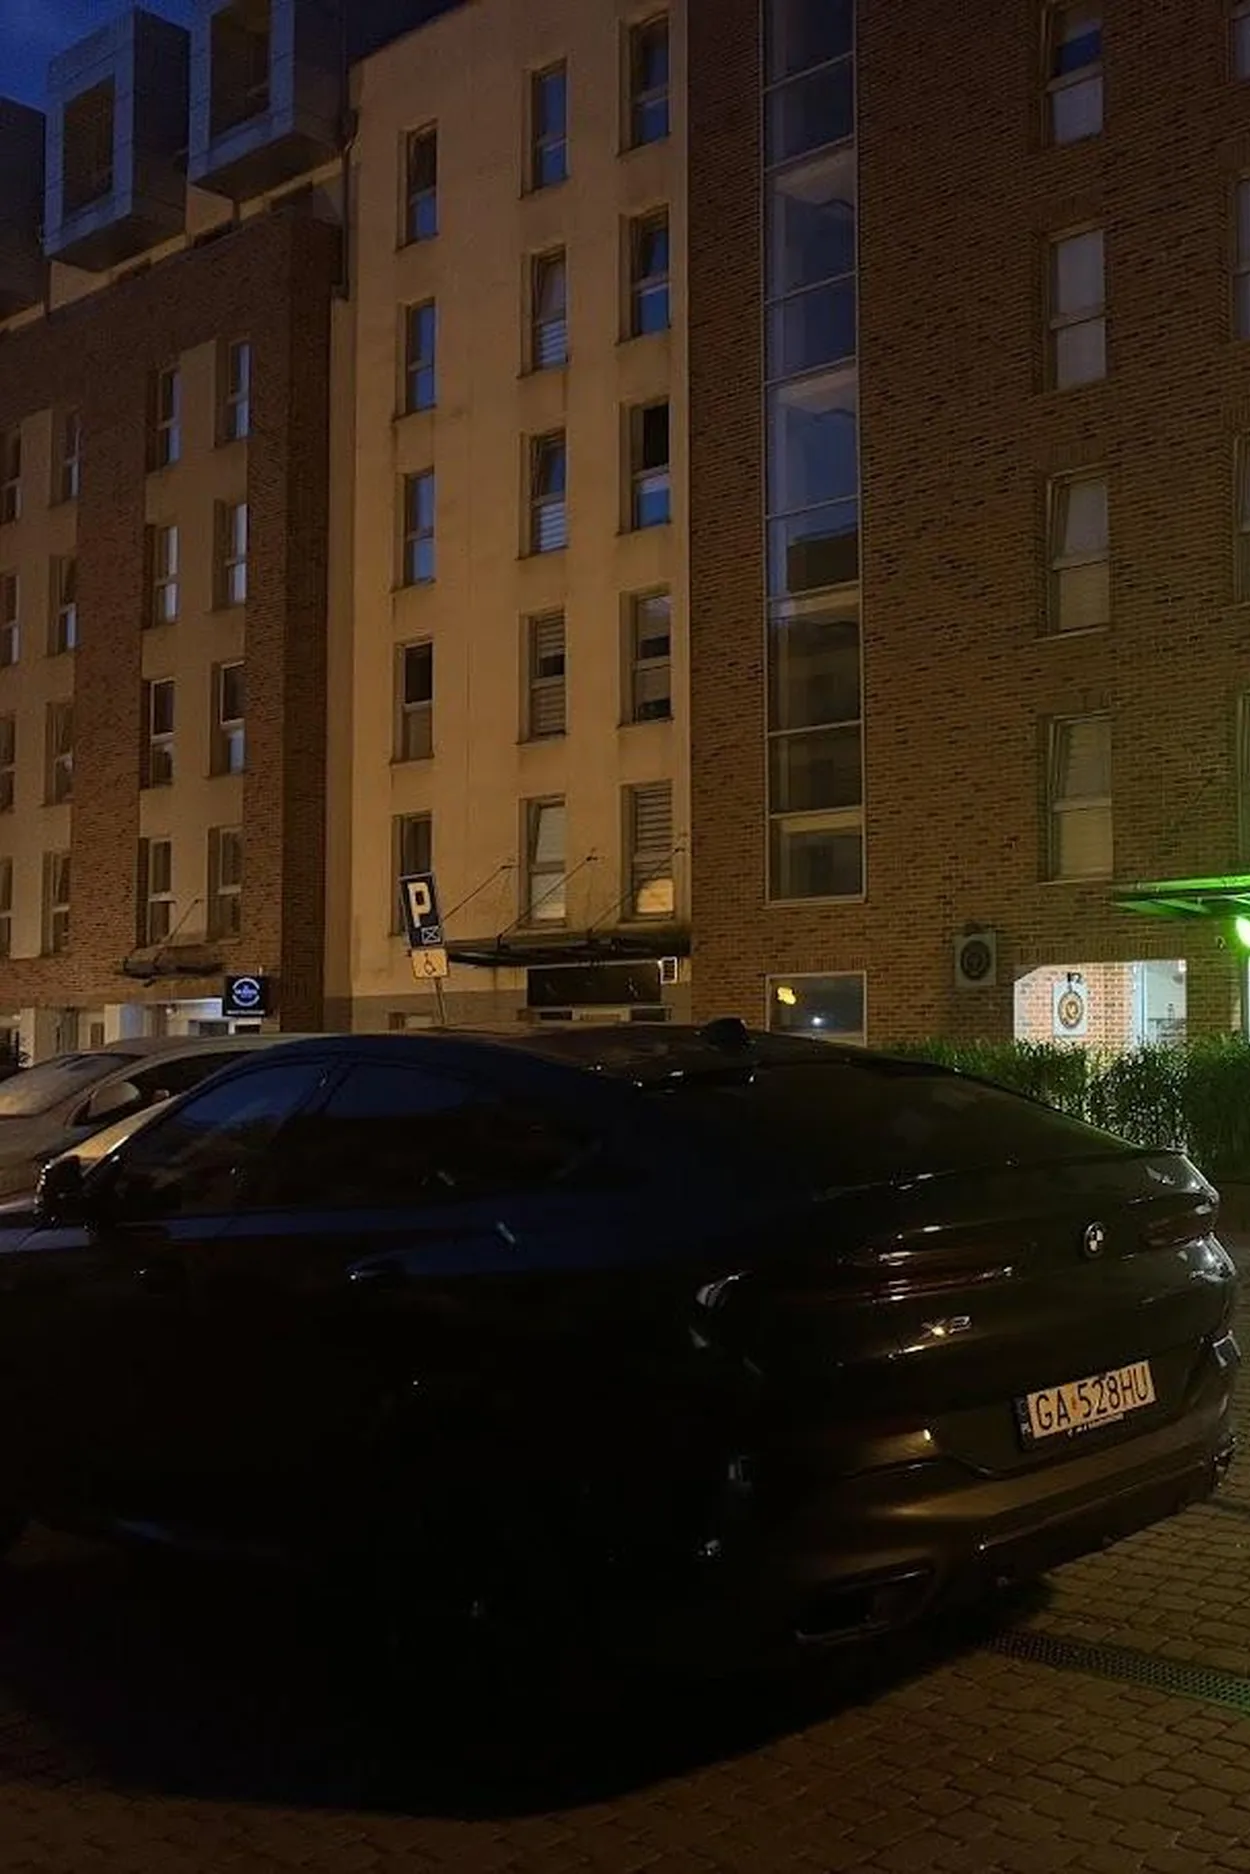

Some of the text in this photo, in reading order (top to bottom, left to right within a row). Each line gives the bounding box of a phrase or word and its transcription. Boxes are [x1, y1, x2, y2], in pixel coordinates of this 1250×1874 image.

[407, 882, 432, 929] P
[1035, 1388, 1071, 1431] GA
[1076, 1364, 1150, 1419] 528HU
